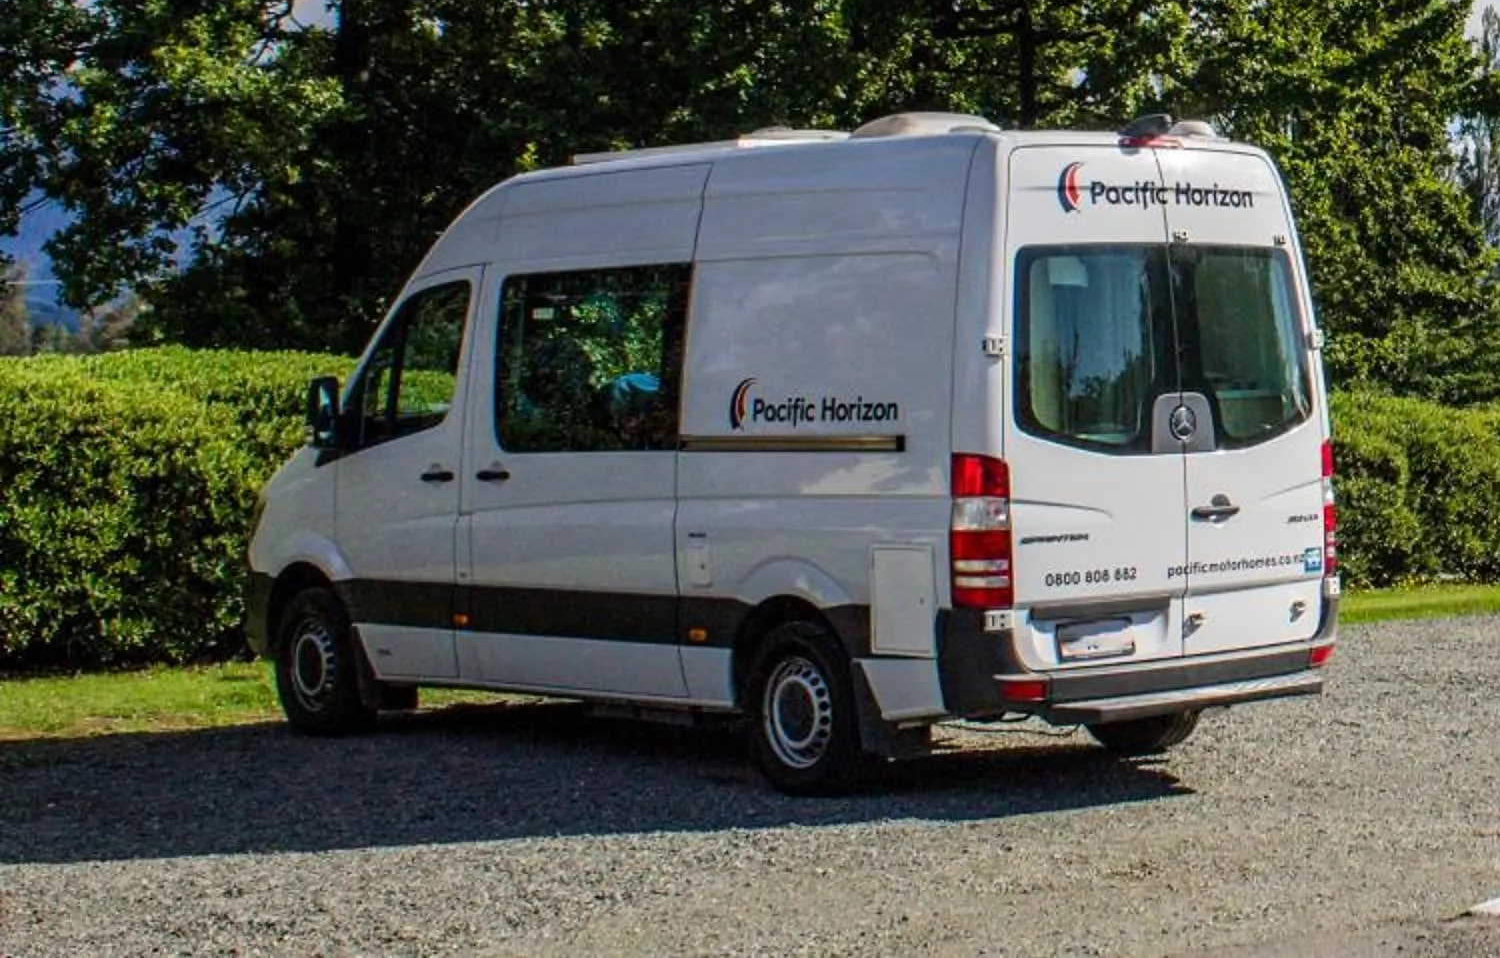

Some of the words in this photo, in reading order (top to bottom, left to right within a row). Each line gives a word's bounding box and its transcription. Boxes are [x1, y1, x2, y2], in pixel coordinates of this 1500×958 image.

[1091, 181, 1168, 209] Pacific
[1175, 182, 1254, 208] Horizon
[753, 397, 815, 426] Pacific
[821, 395, 898, 421] Horizon
[1045, 572, 1081, 586] 0800
[1085, 569, 1110, 583] 808
